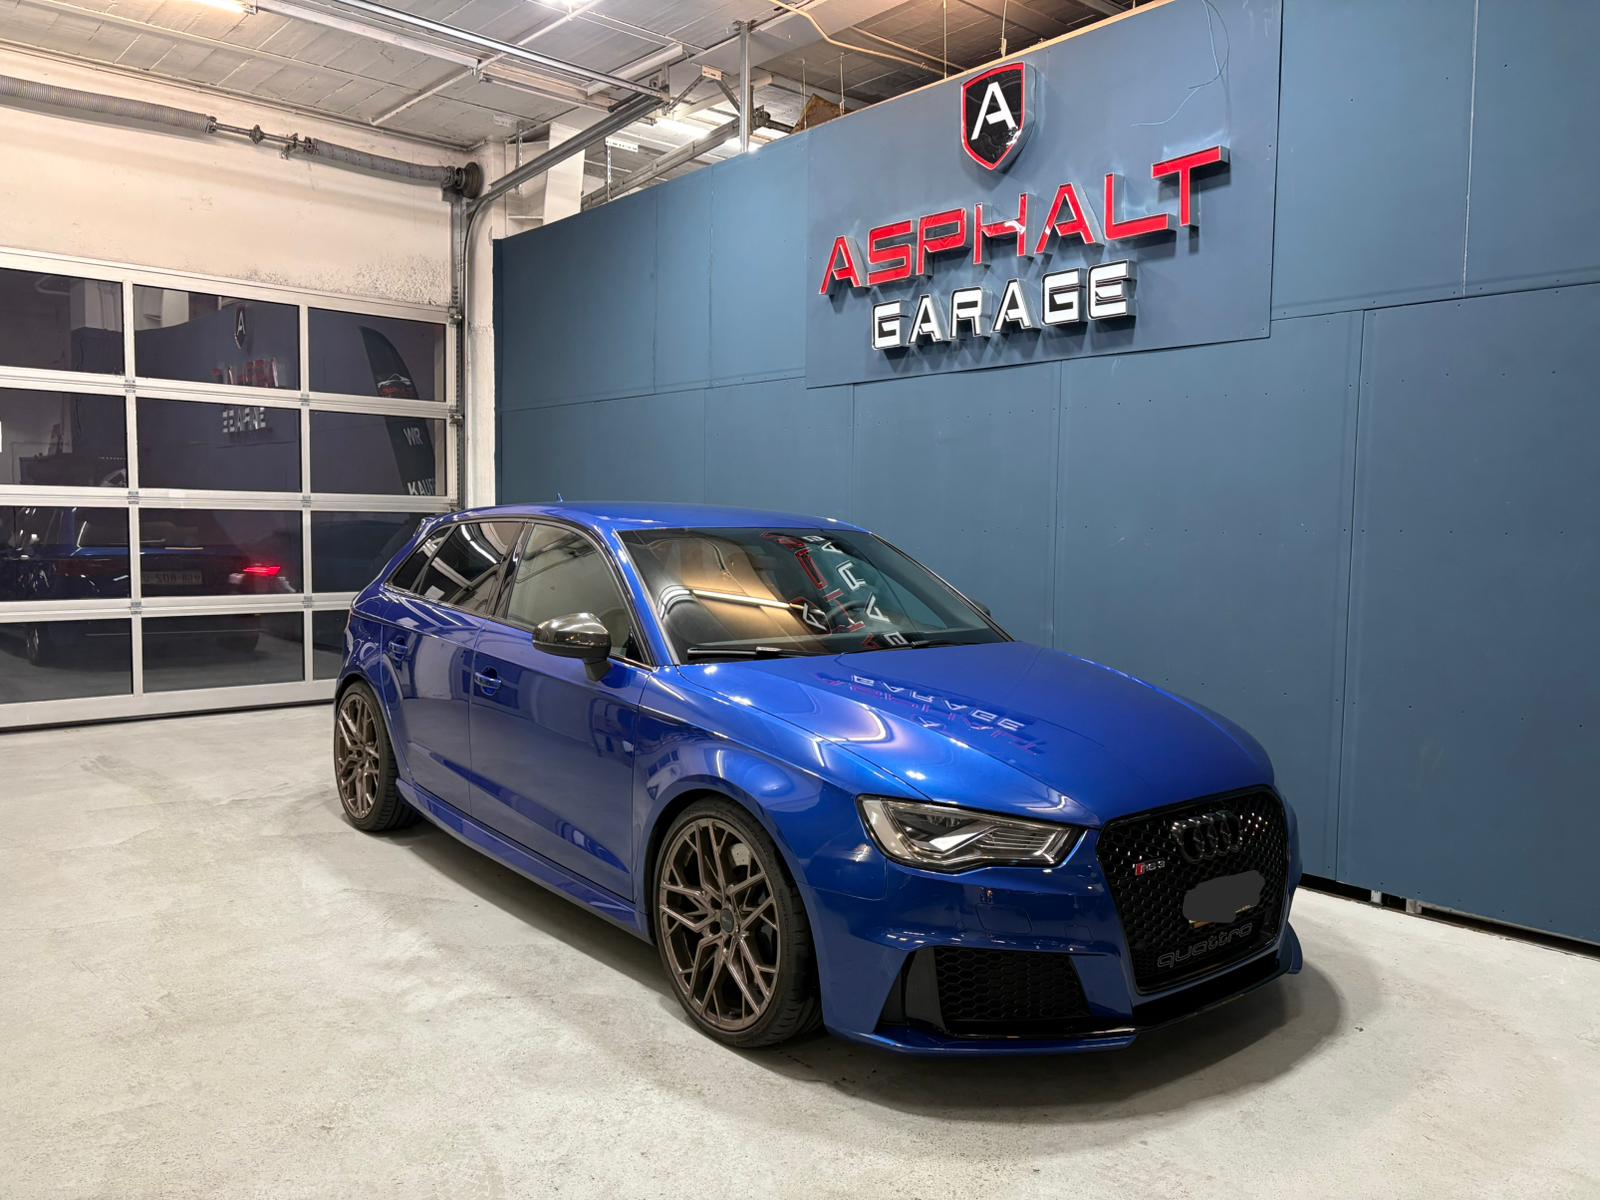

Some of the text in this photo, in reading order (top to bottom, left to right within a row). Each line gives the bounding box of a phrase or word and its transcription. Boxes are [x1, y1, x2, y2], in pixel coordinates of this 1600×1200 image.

[970, 81, 1017, 141] A
[819, 145, 1225, 295] ASPHALT
[871, 259, 1131, 351] GARAGE
[1157, 922, 1253, 968] quattro
